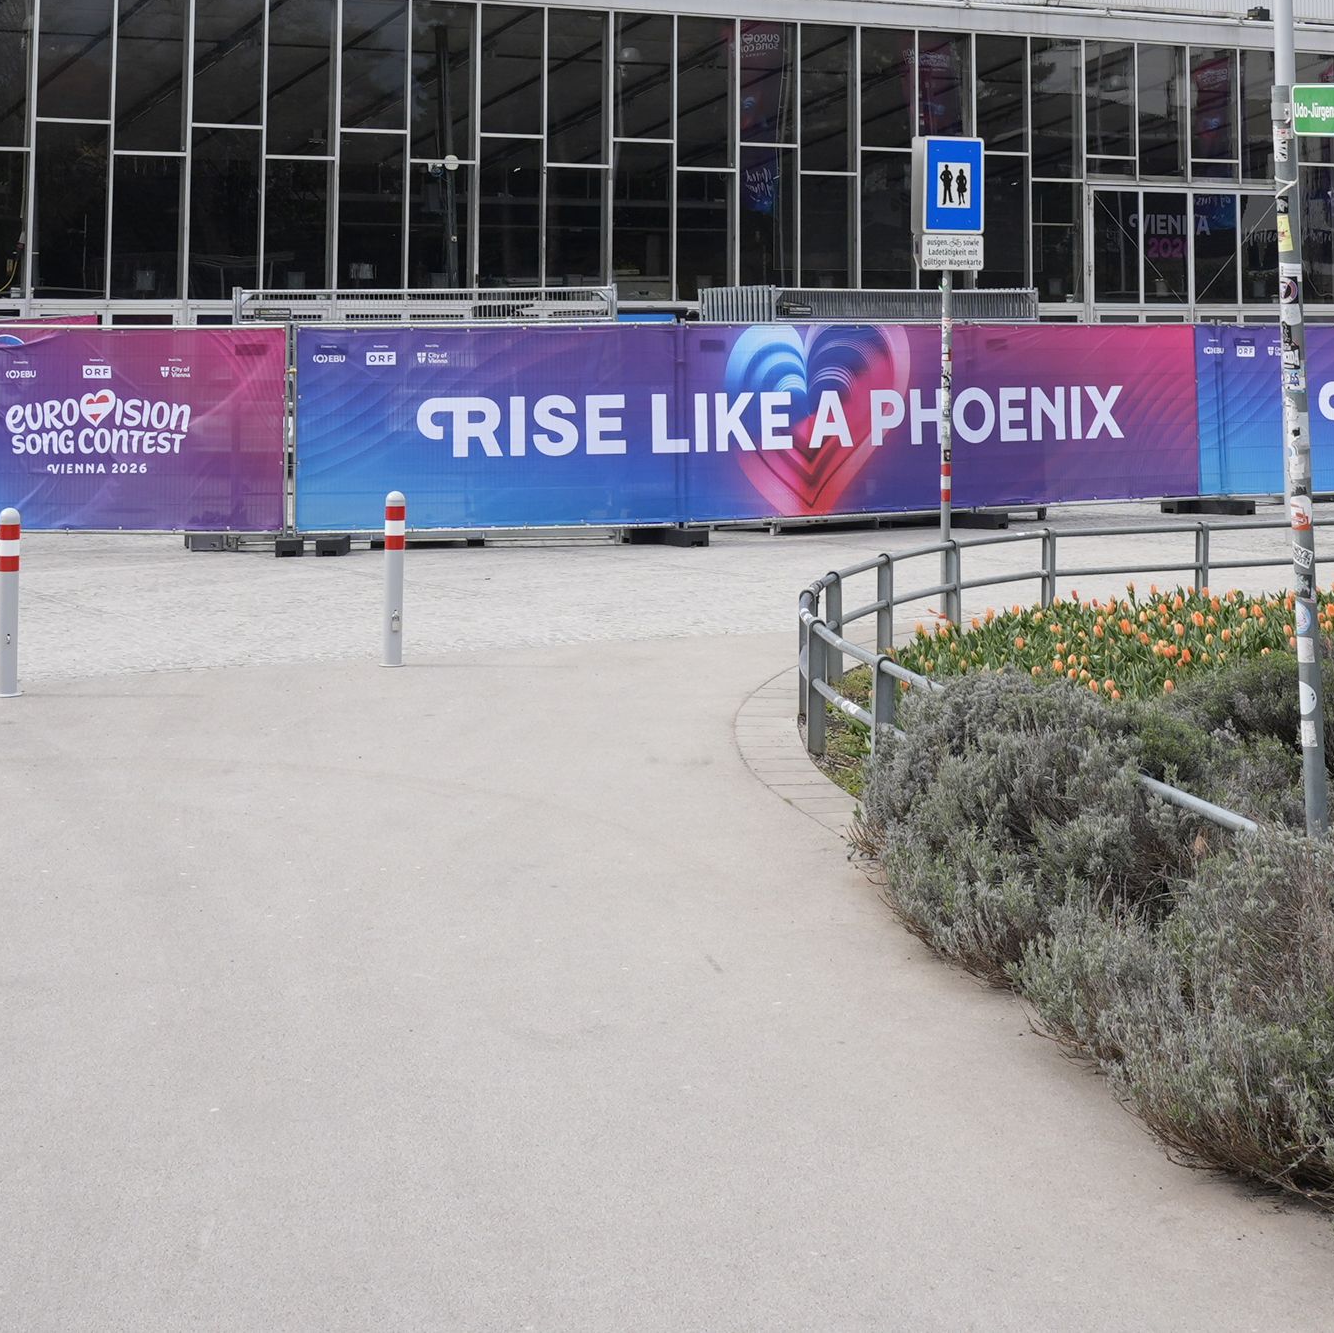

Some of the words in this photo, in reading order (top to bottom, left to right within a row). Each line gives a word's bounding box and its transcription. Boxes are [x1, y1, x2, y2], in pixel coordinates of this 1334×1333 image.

[927, 239, 949, 247] ausgen.
[963, 238, 979, 246] sowie
[928, 248, 967, 257] Ladetätigkeit
[949, 259, 982, 267] Wagenkarte
[369, 354, 394, 363] ORF
[428, 352, 440, 360] City
[85, 368, 109, 376] ORF
[416, 394, 627, 458] RISE
[651, 392, 794, 454] LIKE
[809, 390, 853, 449] A
[870, 385, 1124, 446] PHOENIX
[11, 429, 74, 455] SONG
[78, 428, 187, 454] CONTEST
[47, 463, 106, 475] VIENNA
[111, 463, 148, 474] 2026
